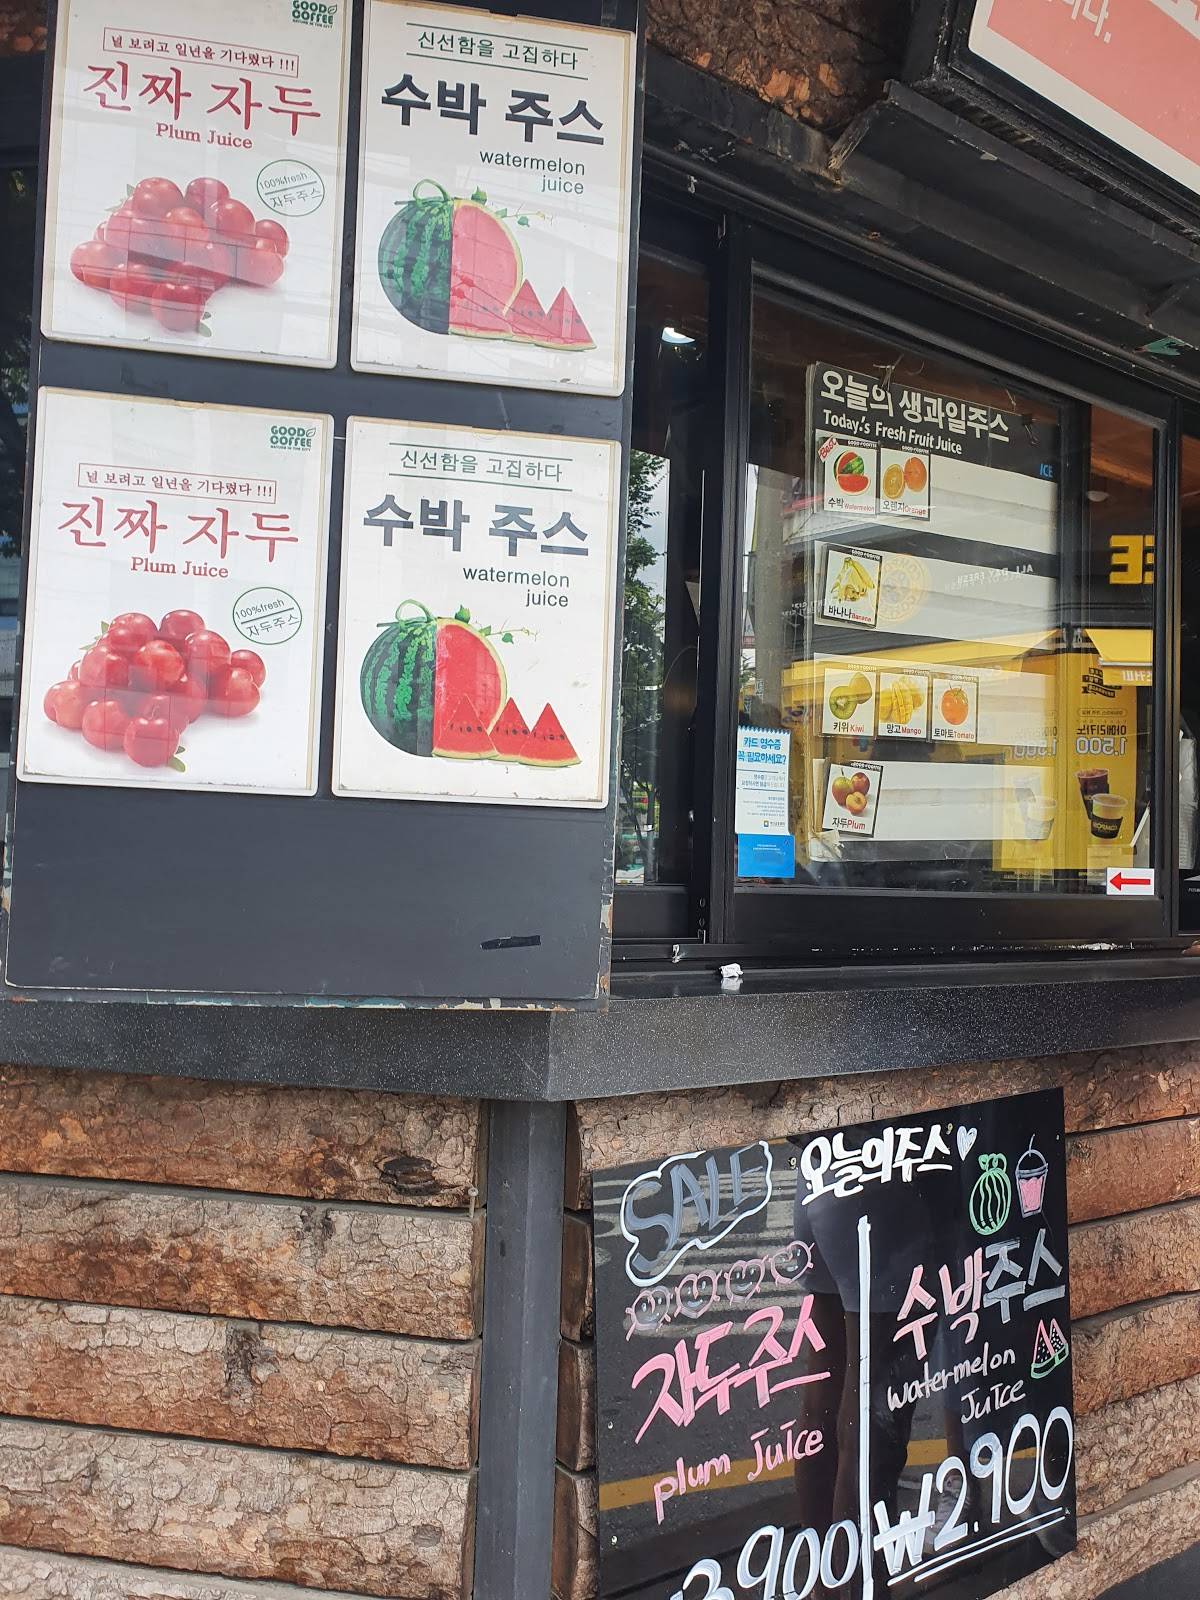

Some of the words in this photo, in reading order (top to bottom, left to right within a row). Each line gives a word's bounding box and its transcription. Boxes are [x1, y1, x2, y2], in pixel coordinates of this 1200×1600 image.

[292, 0, 327, 13] GOOD
[292, 10, 333, 24] COFFEE
[129, 38, 170, 54] 보려고
[176, 43, 215, 60] 일년을
[220, 49, 274, 68] 기다렸다
[418, 31, 494, 58] 신선함을
[502, 43, 578, 71] 고집하다
[83, 60, 192, 120] 진짜
[206, 77, 321, 136] 자두
[381, 73, 487, 136] 수박
[505, 89, 604, 146] 주스
[155, 122, 201, 143] Plum
[207, 130, 253, 149] Juice
[480, 150, 585, 176] watermelon
[541, 174, 584, 195] juice
[270, 187, 322, 208] 자두주스
[820, 370, 894, 417] 오늘의
[899, 389, 1010, 442] 생과일주스
[270, 425, 306, 437] GOOD
[270, 435, 312, 447] COFFEE
[875, 421, 906, 444] Fresh
[908, 428, 934, 450] Fruit
[936, 434, 962, 455] Juice
[400, 450, 478, 474] 신선함을
[486, 458, 562, 483] 고집하다
[1039, 463, 1054, 479] ICE
[87, 470, 98, 484] 널
[104, 473, 145, 487] 보려고
[152, 475, 192, 492] 일년을
[197, 480, 252, 496] 기다렸다
[828, 497, 844, 508] 수박
[883, 499, 904, 513] 오렌지
[58, 496, 168, 554] 진짜
[182, 507, 299, 563] 자두
[363, 494, 470, 552] 수박
[488, 504, 589, 557] 주스
[130, 556, 177, 574] Plum
[182, 560, 229, 578] Juice
[463, 566, 570, 588] watermelon
[525, 589, 568, 608] juice
[828, 605, 851, 618] 바나나
[246, 614, 300, 637] 자두주스
[833, 721, 849, 733] 키위
[850, 723, 865, 733] Kiwi
[886, 723, 902, 735] 망고
[901, 725, 922, 736] Mango
[933, 727, 954, 739] 토마토
[743, 736, 758, 749] 카드
[760, 737, 782, 751] 영수증
[747, 750, 787, 766] 필요하세요?
[831, 816, 848, 829] 자두
[847, 819, 866, 831] Plum
[800, 1126, 953, 1206] 오늘의주스
[624, 1147, 762, 1273] SALE
[893, 1228, 1066, 1361] 수박주스
[631, 1294, 831, 1444] 자두주스
[886, 1344, 1017, 1413] watermelon
[654, 1453, 731, 1525] plum
